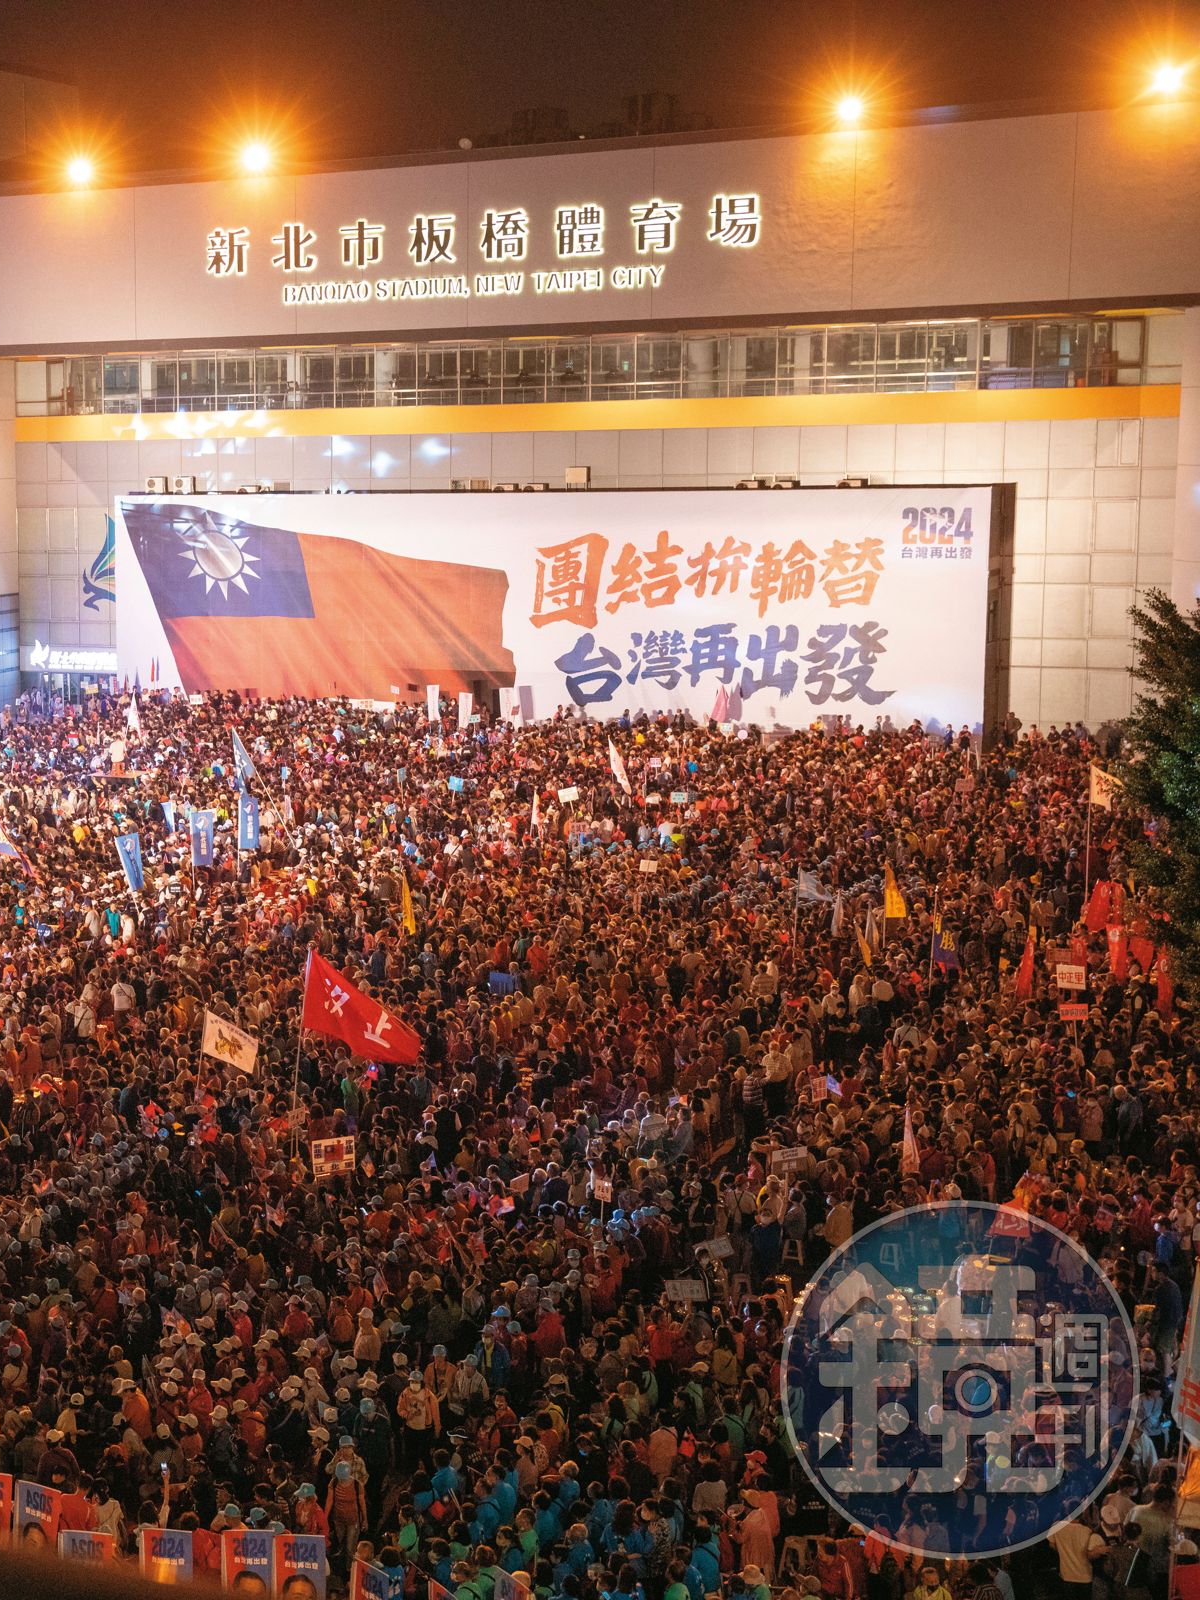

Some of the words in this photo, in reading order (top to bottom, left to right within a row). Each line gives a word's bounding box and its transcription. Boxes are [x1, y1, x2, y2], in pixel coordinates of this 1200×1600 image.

[205, 195, 760, 275] 新北市板橋體育場
[284, 282, 369, 303] BANQIAO
[376, 276, 469, 299] STADIUM,
[476, 273, 523, 294] NEW
[532, 269, 601, 290] TAIPEI
[612, 265, 665, 287] CITY
[902, 507, 973, 545] 2024
[901, 546, 972, 559] 台灣再出發
[529, 530, 886, 629] 團結拚輪替
[554, 621, 897, 707] 台灣再出發
[1058, 970, 1084, 985] 中正里
[152, 1536, 184, 1558] 2024
[232, 1537, 268, 1557] 2024
[283, 1541, 319, 1562] 2024
